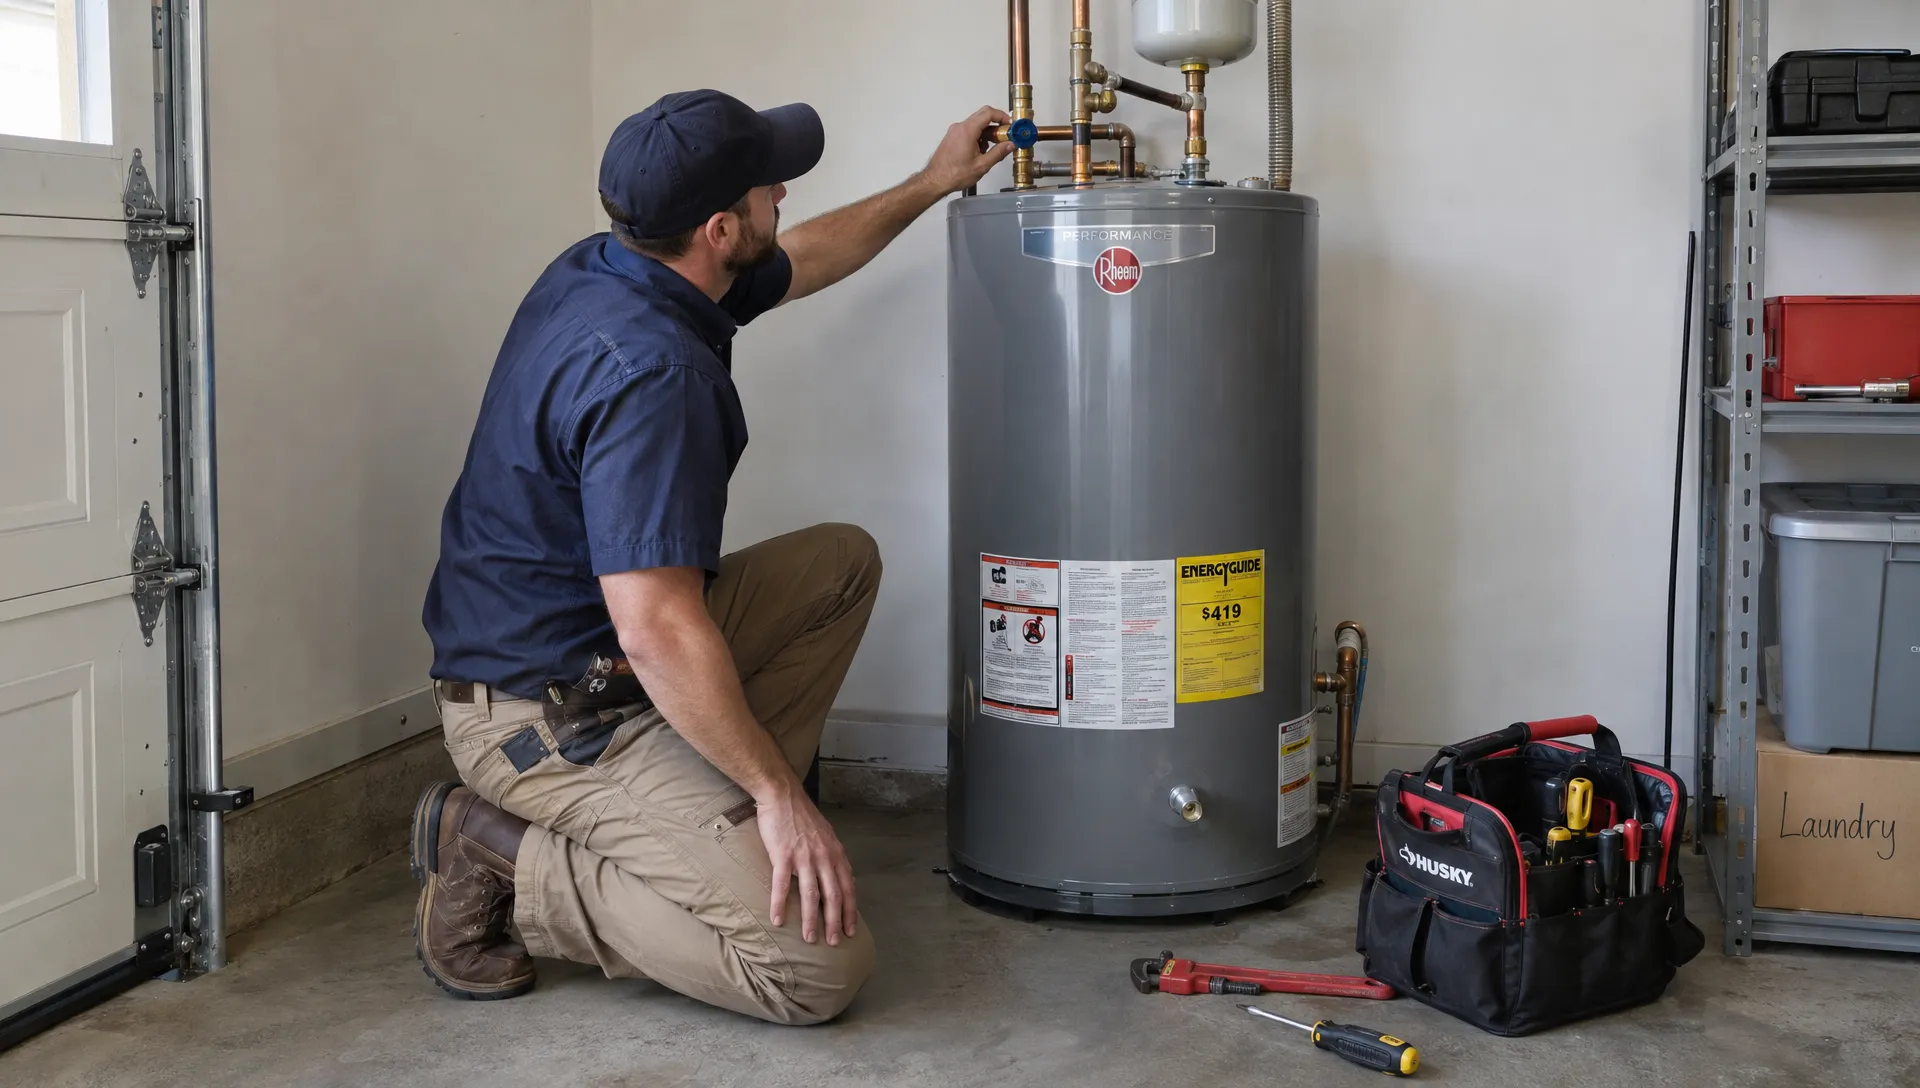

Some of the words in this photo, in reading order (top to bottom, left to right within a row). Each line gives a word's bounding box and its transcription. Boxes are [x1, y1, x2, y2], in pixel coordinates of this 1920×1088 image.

[1062, 230, 1173, 242] PERFORMANCE
[1100, 248, 1138, 286] Rheem
[1181, 558, 1261, 586] ENERGYGUIDE
[1202, 603, 1242, 621] $419
[1780, 791, 1896, 860] Laundry
[1416, 853, 1473, 887] HUSKY
